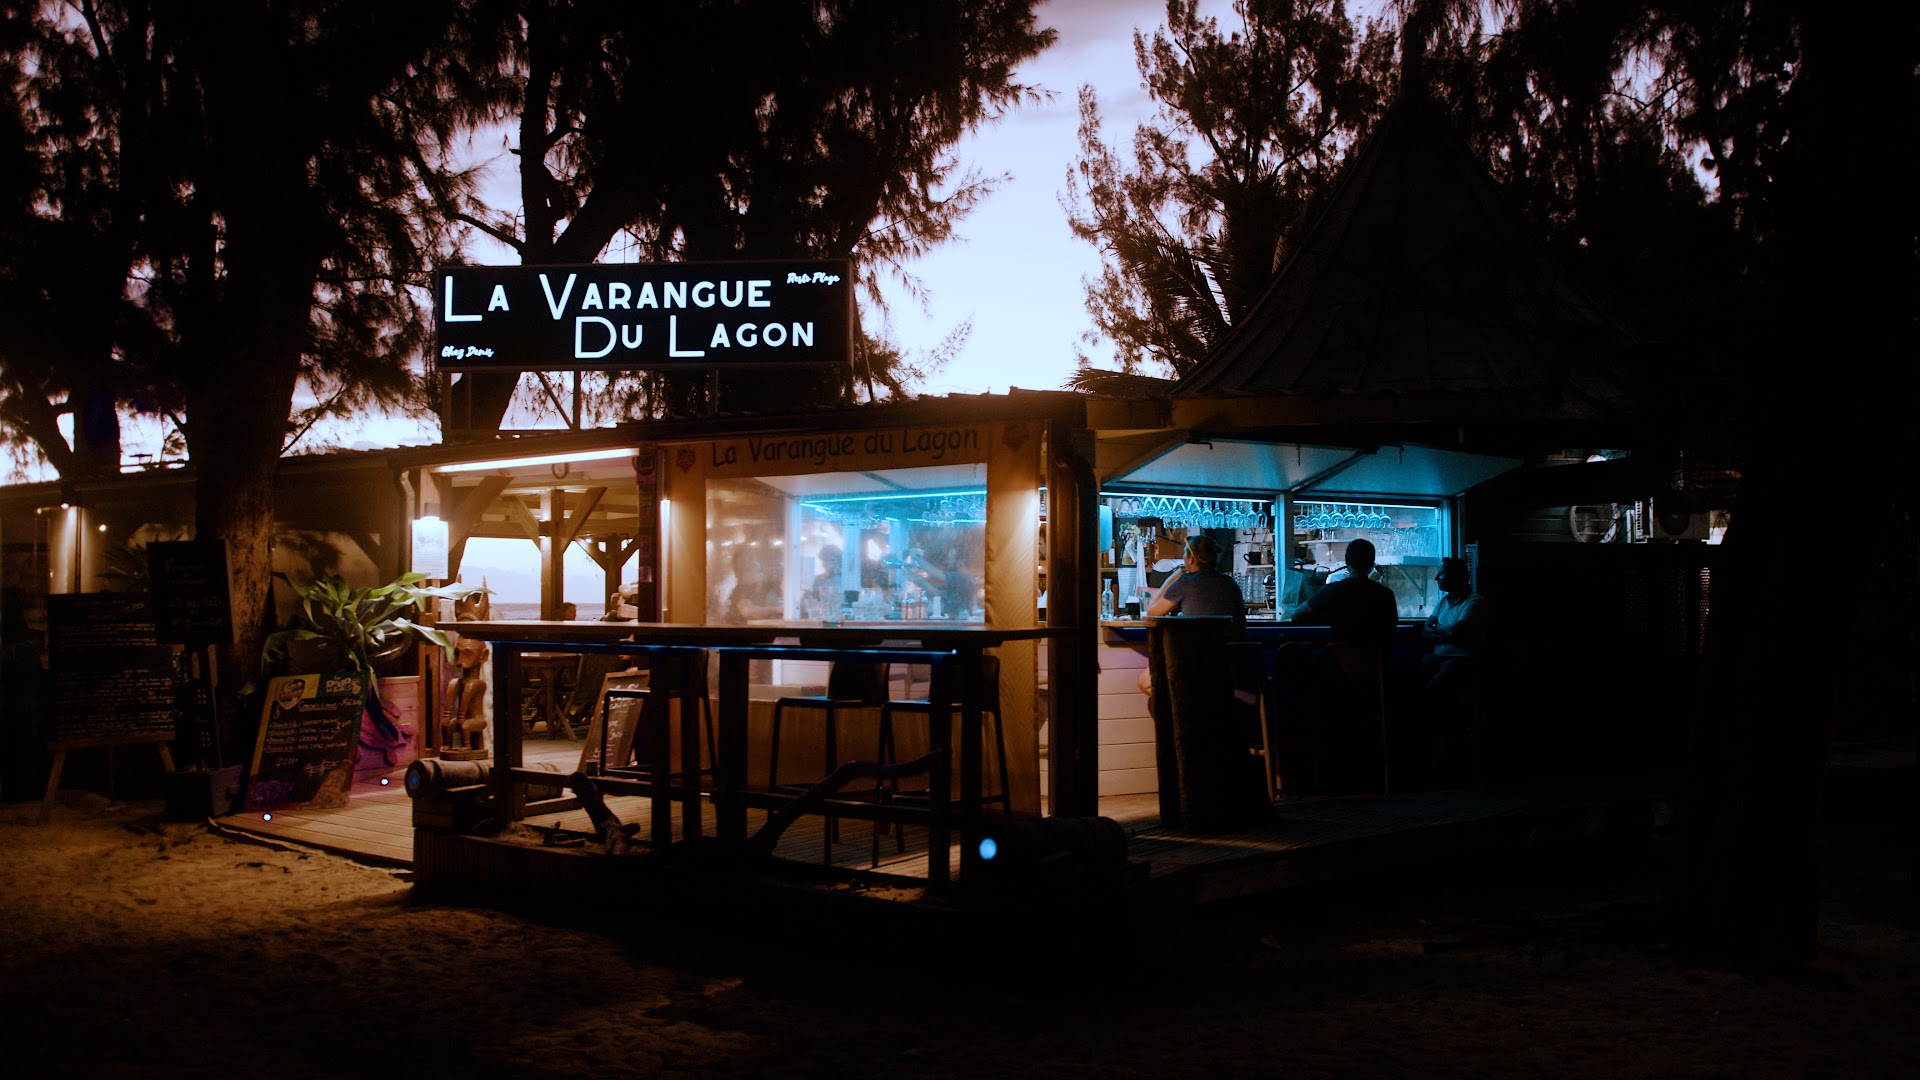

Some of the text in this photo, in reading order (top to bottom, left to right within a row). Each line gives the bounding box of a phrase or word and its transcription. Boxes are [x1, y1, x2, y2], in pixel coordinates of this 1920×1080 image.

[538, 273, 772, 321] VARANGUE
[669, 314, 814, 358] LAGON
[711, 428, 979, 467] La Varangue du Lagon
